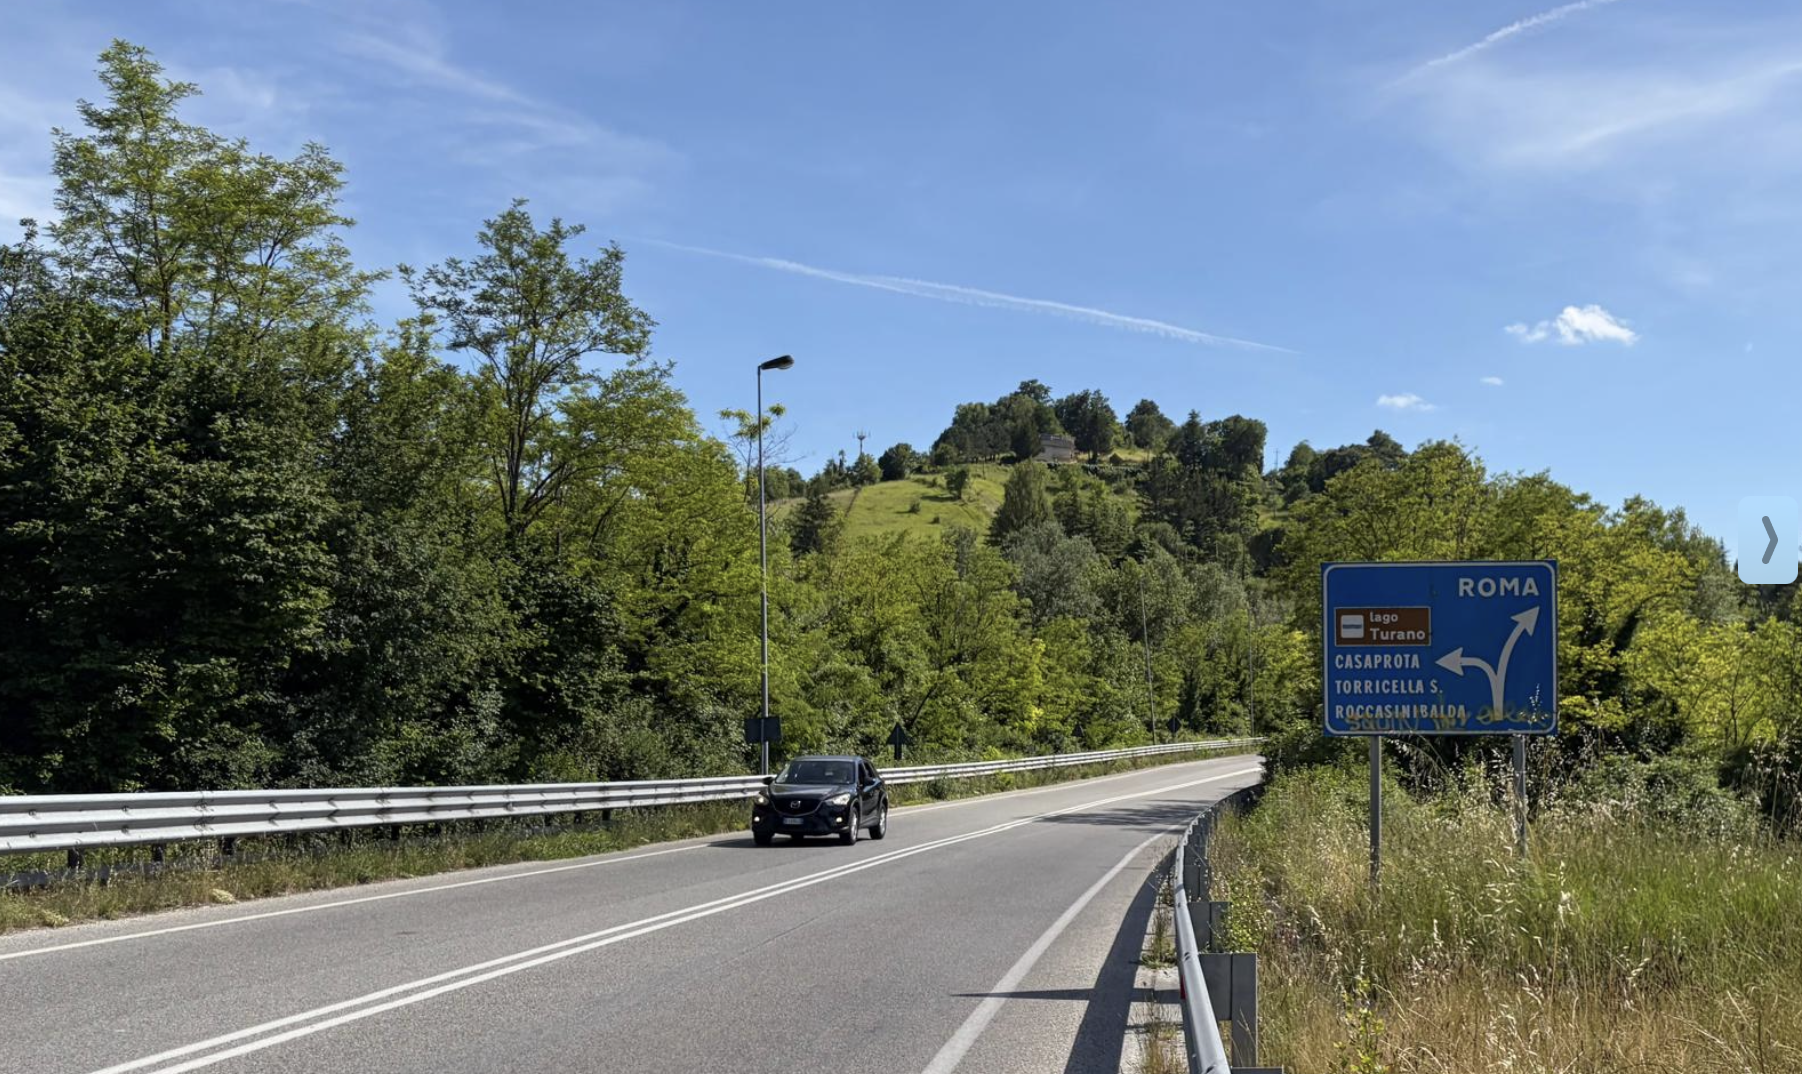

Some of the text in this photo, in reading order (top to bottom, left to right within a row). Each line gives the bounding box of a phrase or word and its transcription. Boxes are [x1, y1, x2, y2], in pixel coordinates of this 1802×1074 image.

[1458, 577, 1540, 597] ROMA
[1370, 611, 1399, 625] lago
[1370, 628, 1426, 641] Turano
[1335, 654, 1420, 669] CASAPROTA
[1335, 679, 1443, 694] TORRICELLA S.
[1335, 704, 1466, 719] ROCCASINIBALDA
